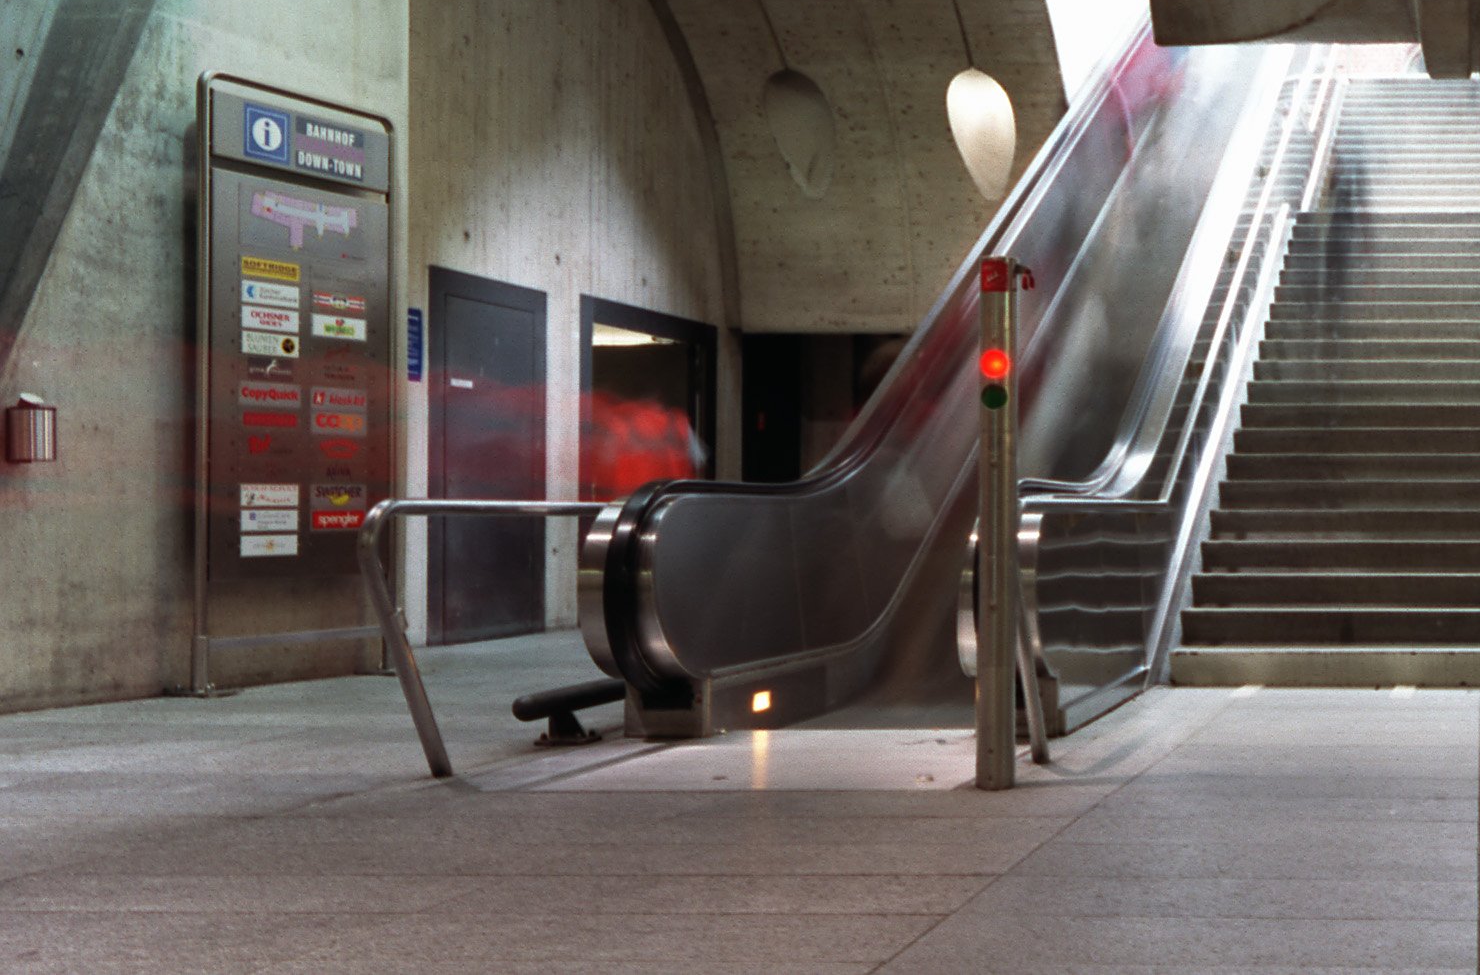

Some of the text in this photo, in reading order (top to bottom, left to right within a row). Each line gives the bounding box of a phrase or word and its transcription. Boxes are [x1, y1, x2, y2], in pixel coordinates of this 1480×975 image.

[306, 122, 355, 147] BAHNHOF
[298, 150, 362, 179] DOWN-TOWN
[250, 310, 290, 322] OCHSNER
[241, 386, 298, 401] CopyQuick
[318, 512, 359, 528] spengler
